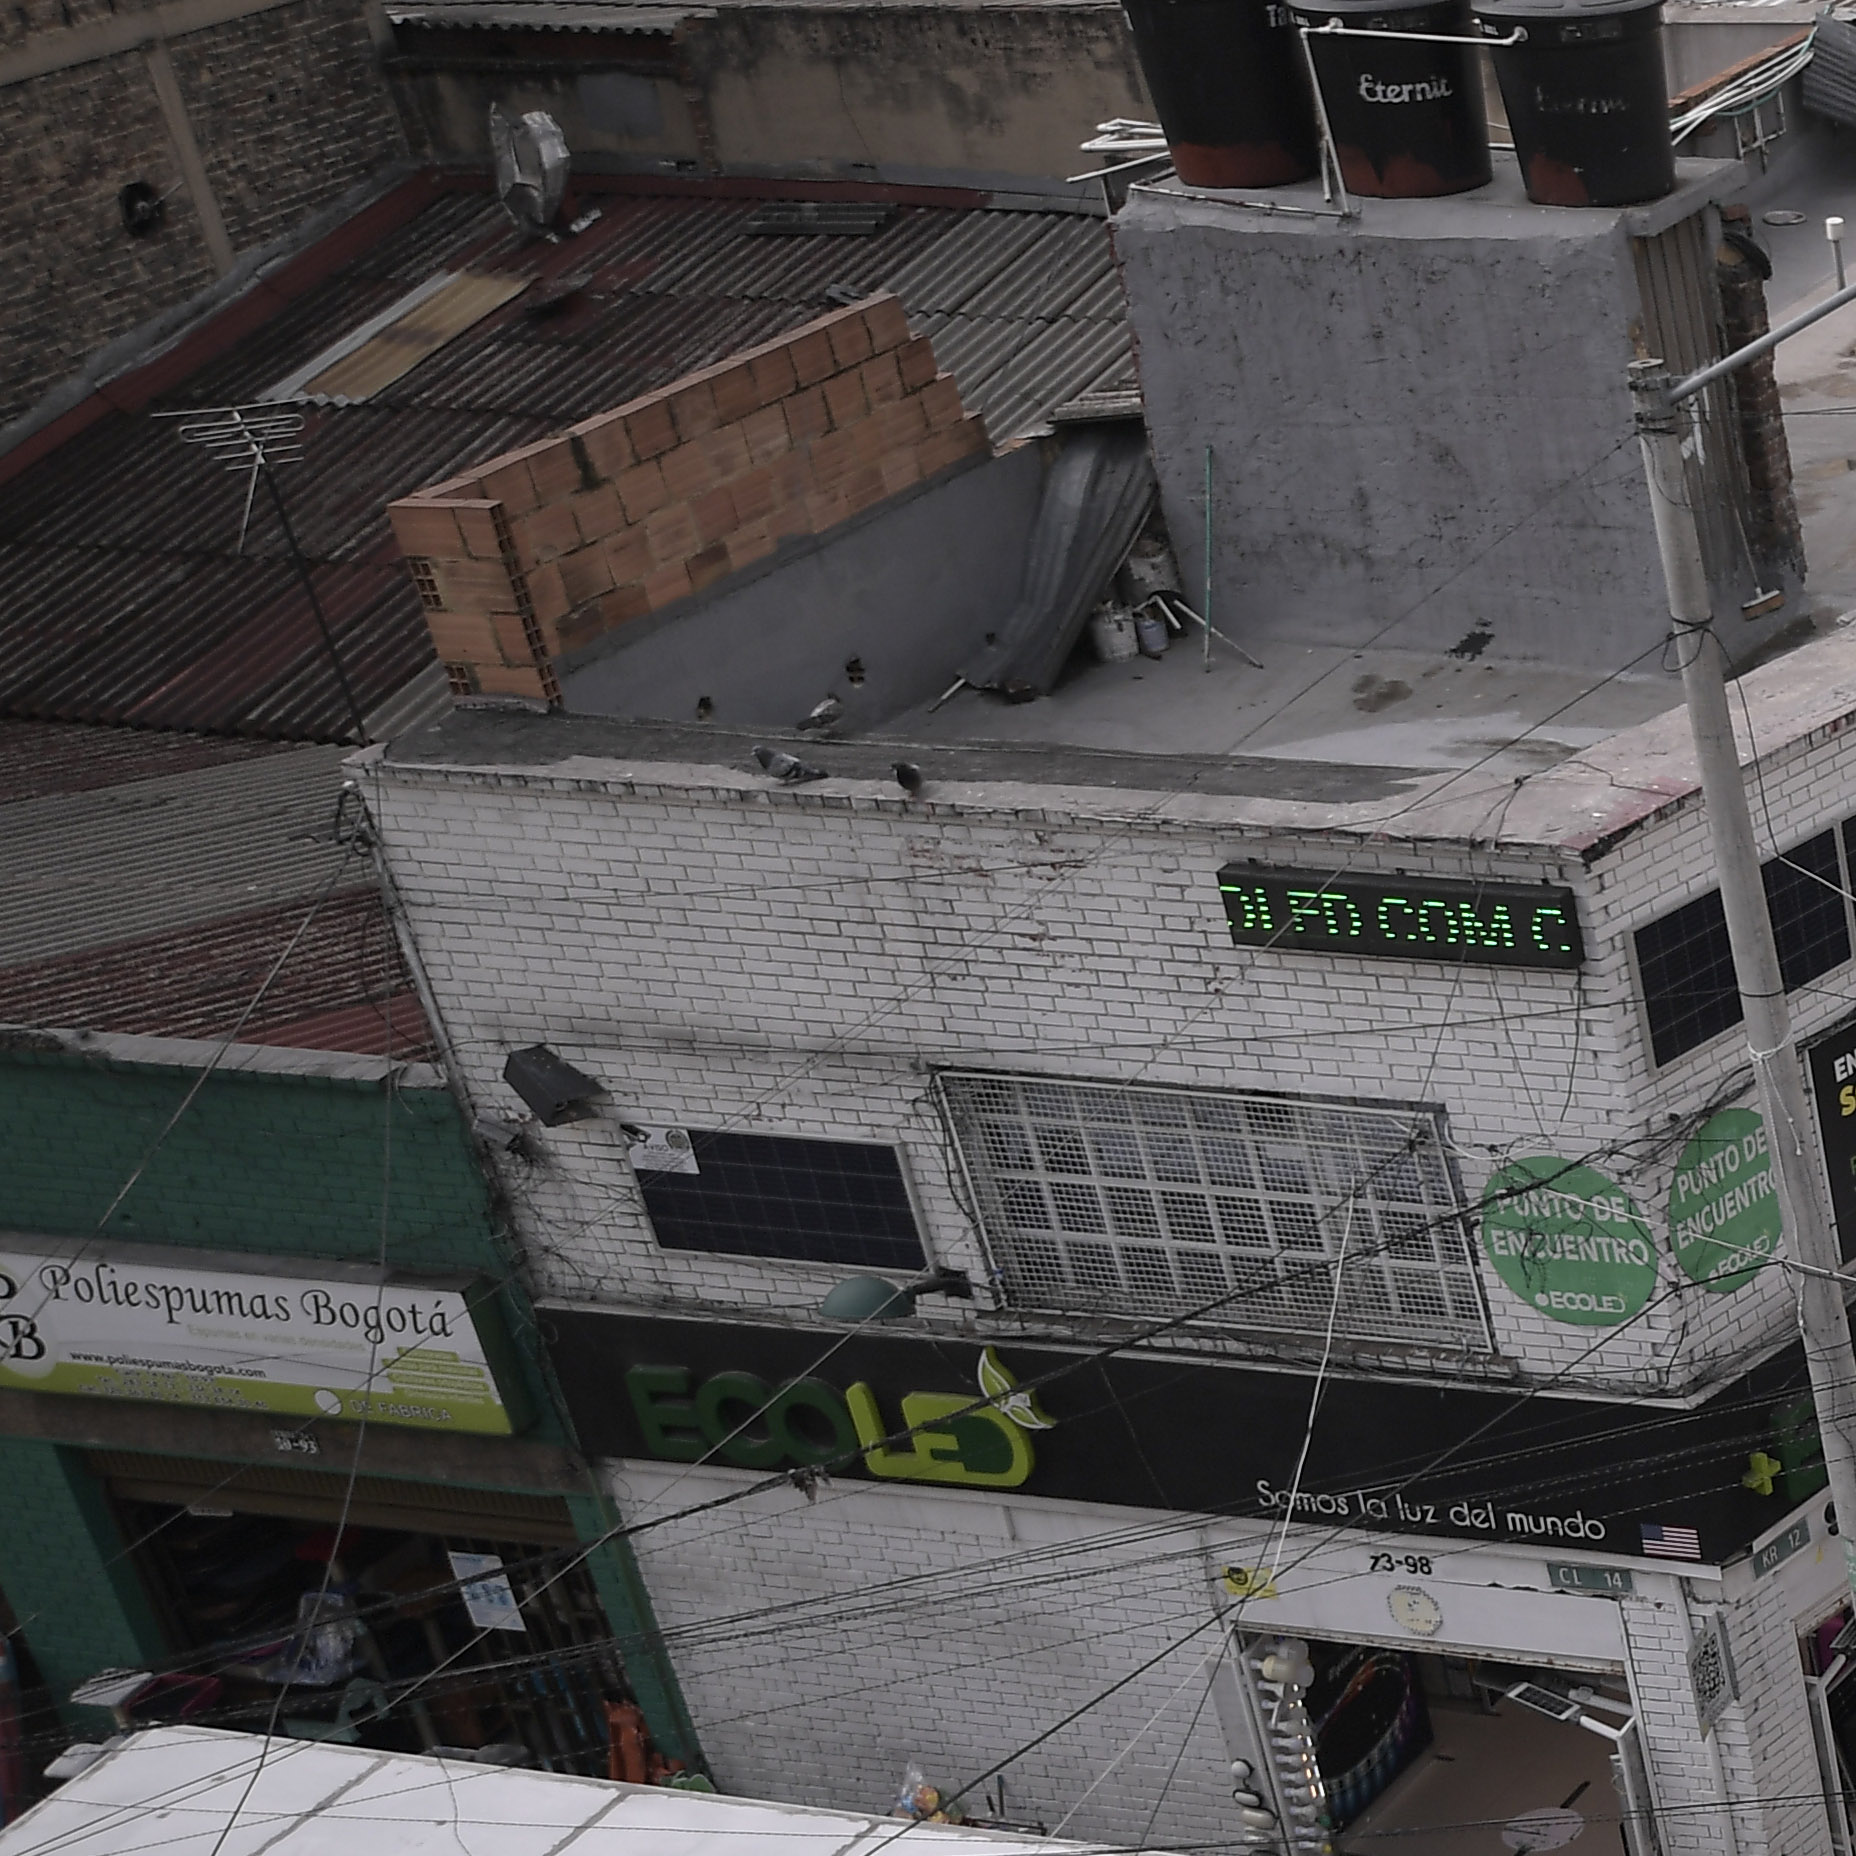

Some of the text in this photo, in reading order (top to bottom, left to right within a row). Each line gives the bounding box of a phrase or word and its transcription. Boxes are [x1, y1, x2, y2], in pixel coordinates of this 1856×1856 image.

[1676, 1128, 1768, 1203] PUNTO DE
[1496, 1185, 1629, 1224] PUNTO DE
[1489, 1228, 1650, 1267] ENCUENTRO
[40, 1262, 454, 1345] Poliespumas Bogotá
[1551, 1293, 1626, 1313] ECOLED
[376, 1401, 453, 1424] FABRICA
[626, 1363, 1036, 1489] ECOLED
[1256, 1479, 1607, 1541] Somos la luz del mundo
[1759, 1529, 1802, 1568] KR 12
[1558, 1567, 1623, 1588] CL 14
